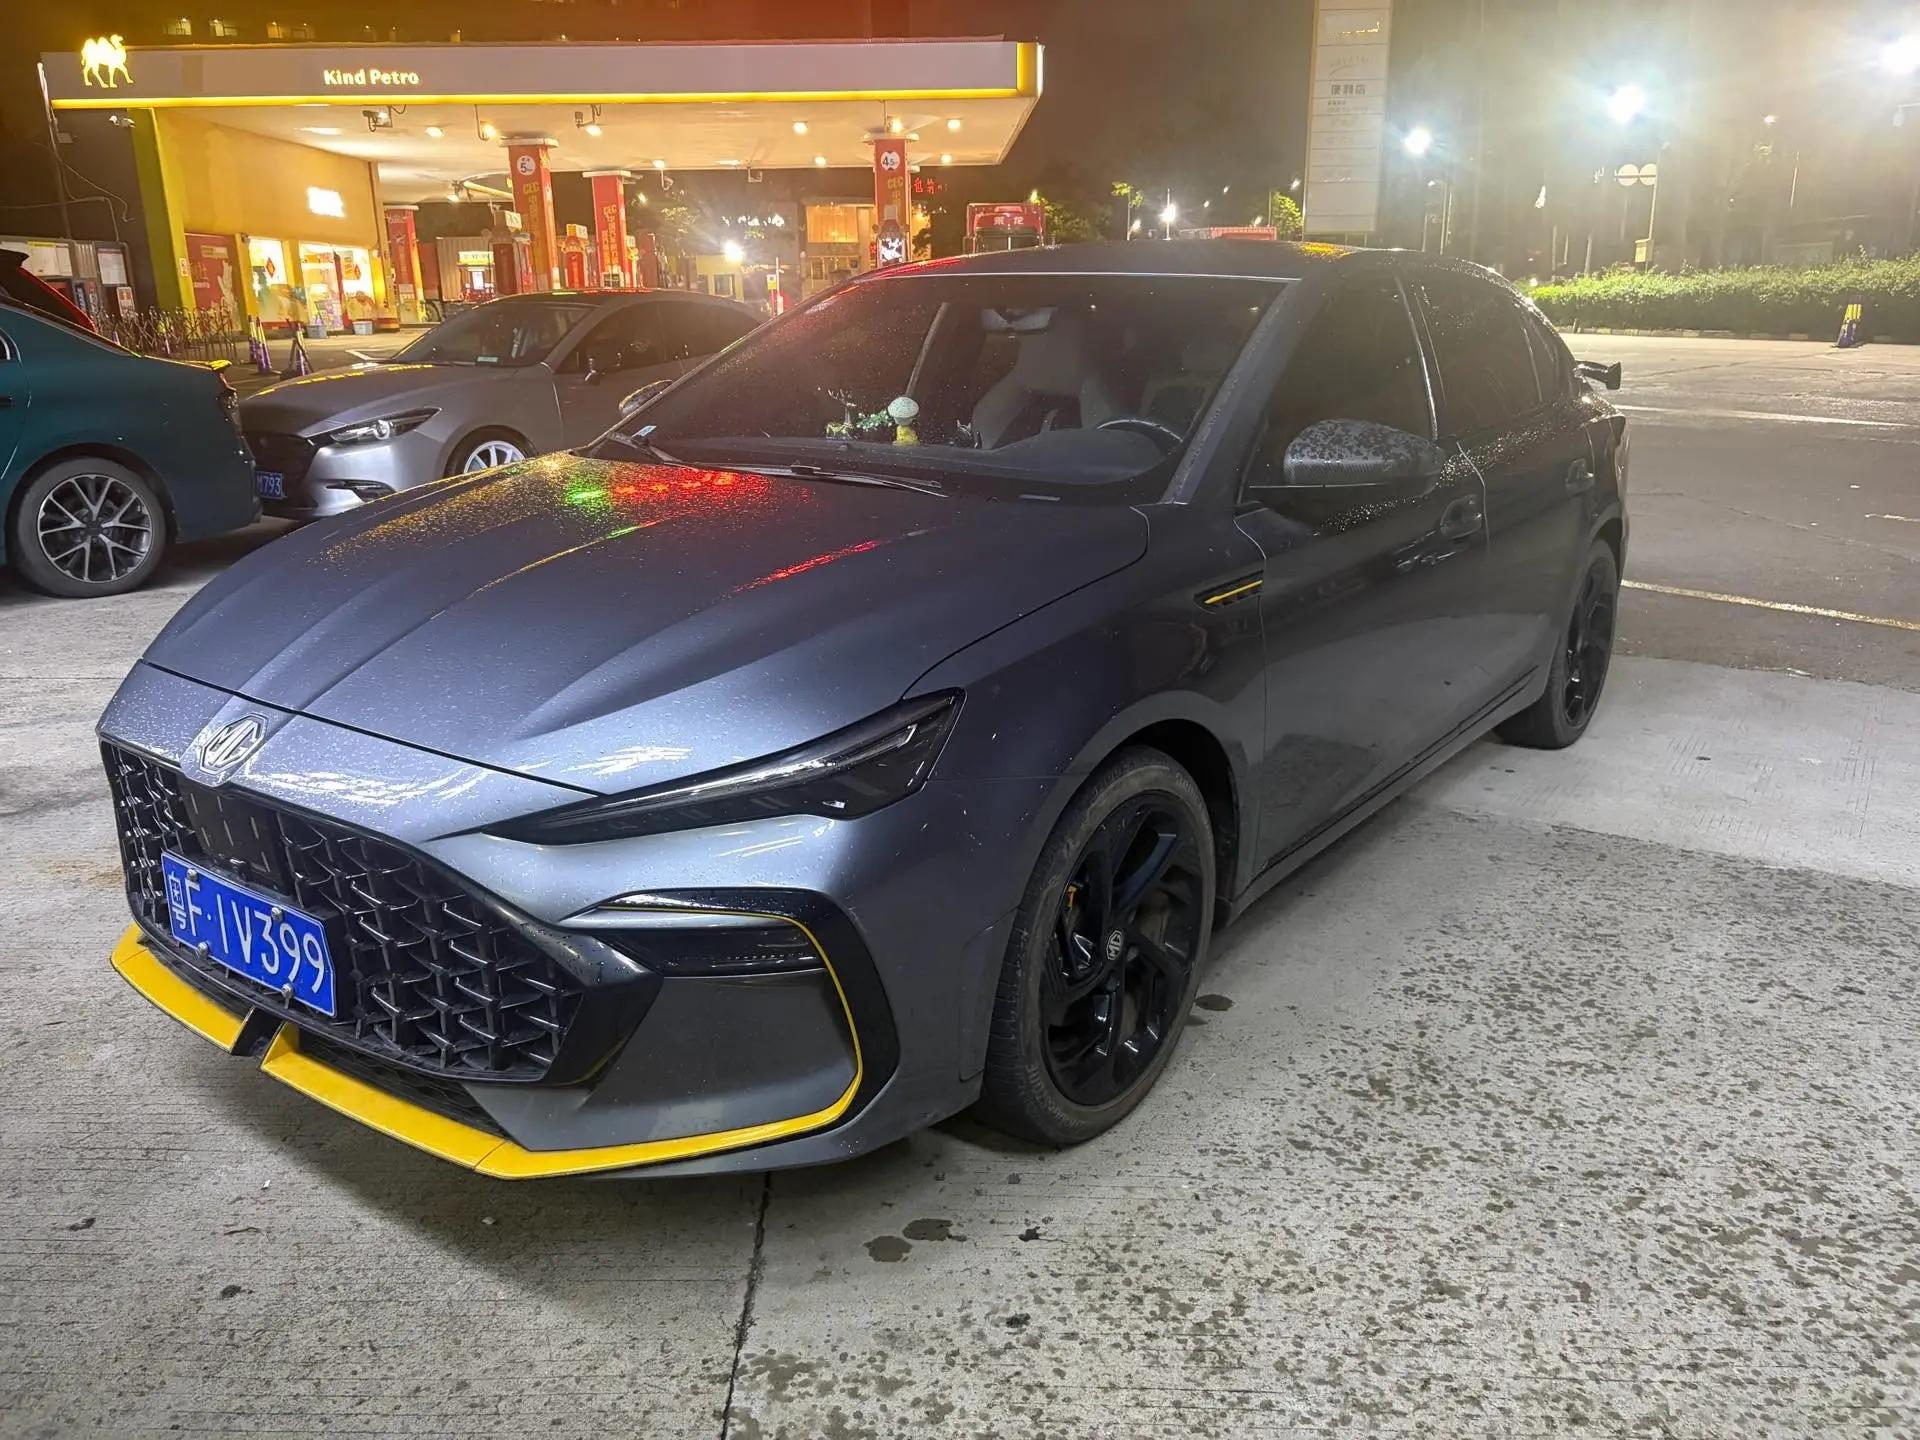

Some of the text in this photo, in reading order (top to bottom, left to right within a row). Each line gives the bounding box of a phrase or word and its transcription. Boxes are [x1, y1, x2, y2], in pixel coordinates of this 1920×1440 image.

[323, 68, 420, 85] Kind Petro
[202, 717, 263, 771] MG
[1107, 932, 1121, 959] MG
